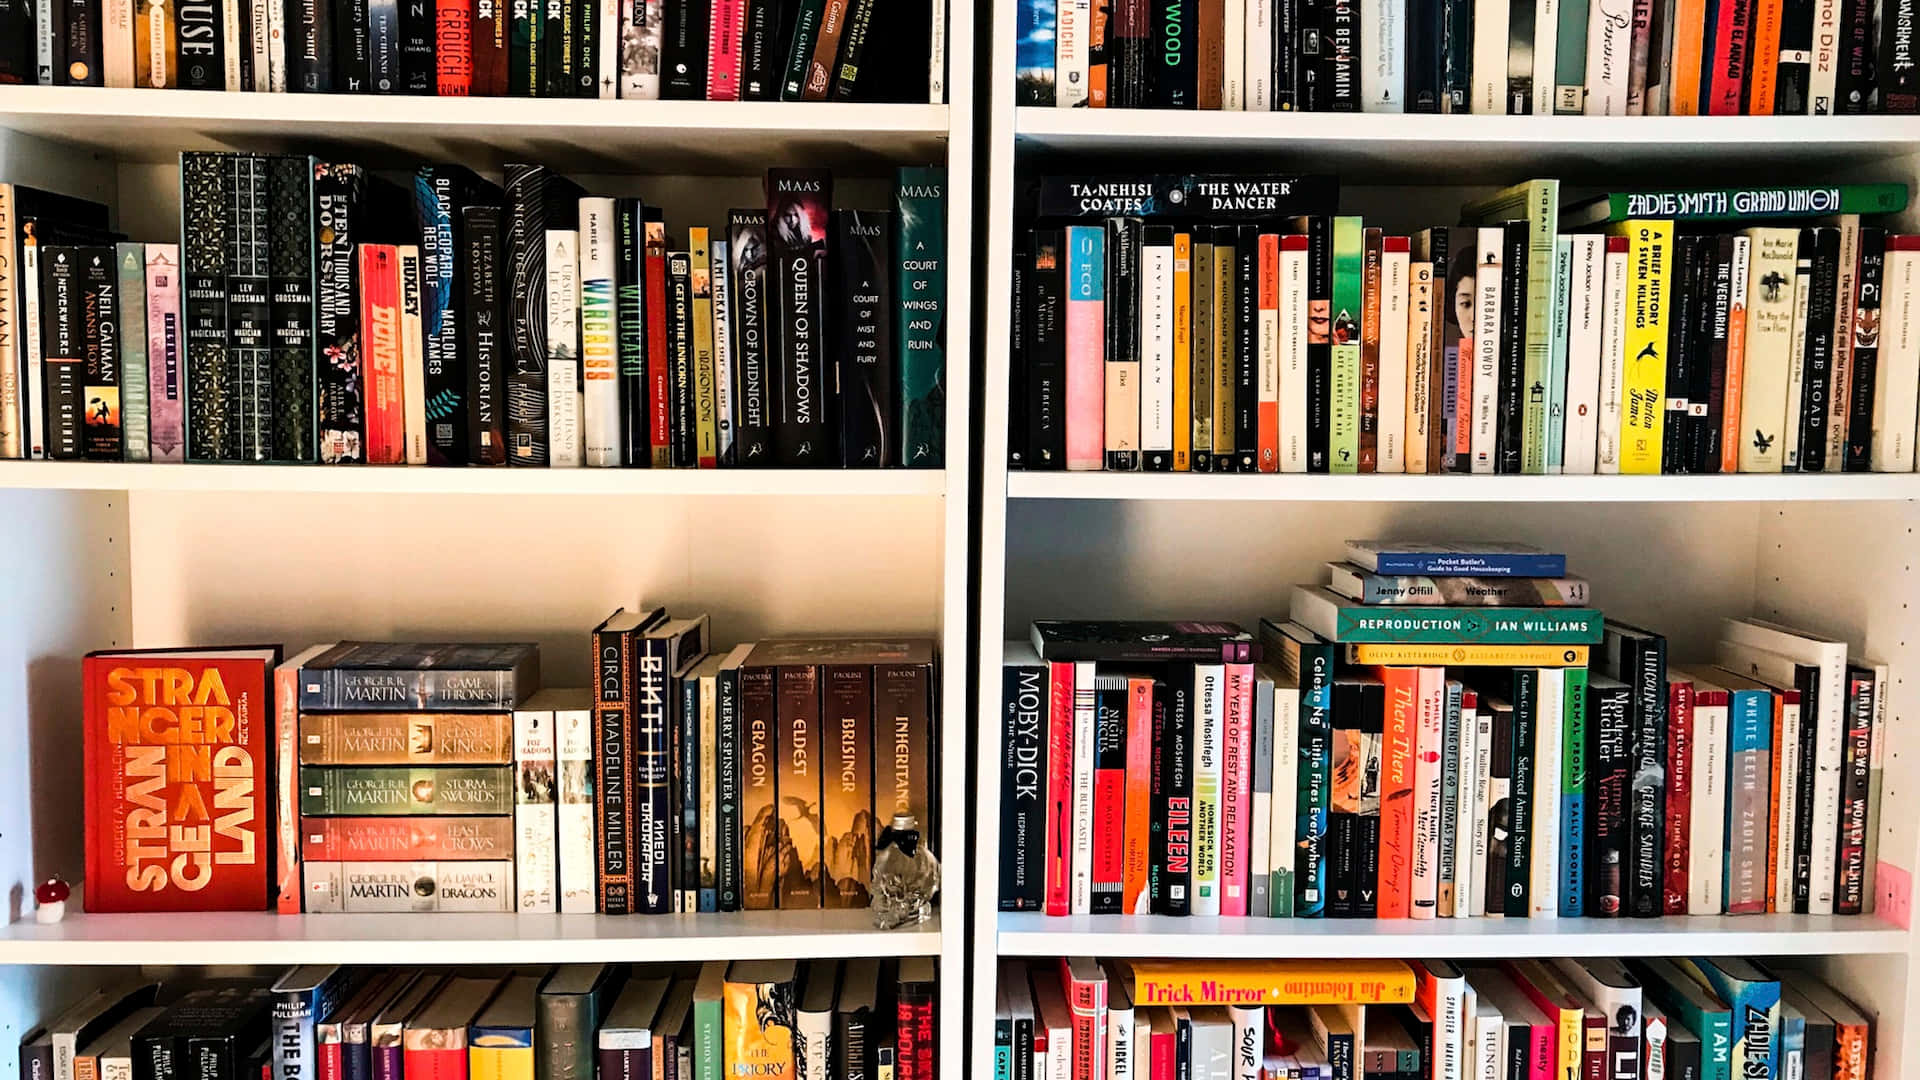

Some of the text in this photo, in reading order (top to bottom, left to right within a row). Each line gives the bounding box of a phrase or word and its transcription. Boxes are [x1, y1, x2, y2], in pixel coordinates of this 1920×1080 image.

[443, 9, 461, 76] CROUCH
[752, 33, 763, 71] GAIMAN
[1061, 10, 1073, 60] ADICHIE
[1336, 28, 1350, 98] BENJAMIN
[779, 179, 820, 191] MAAS
[901, 185, 939, 197] MAAS
[1080, 198, 1142, 211] COATES
[1199, 182, 1290, 195] THE WATER
[1212, 197, 1276, 210] DANCER
[1627, 192, 1727, 215] ZADIE SMITH
[1734, 188, 1840, 212] GRAND UNION
[435, 178, 454, 278] BLACK LEOPARD
[733, 215, 765, 224] MAAS
[916, 241, 925, 250] A
[1640, 229, 1648, 242] OF
[333, 208, 352, 316] TEN THOUSAND
[424, 226, 438, 288] RED WOLF
[515, 205, 526, 299] NIGHT OCEAN
[591, 248, 598, 261] LU
[624, 248, 631, 261] LU
[903, 261, 938, 271] COURT
[1650, 232, 1662, 326] A BRIEF HISTORY
[403, 256, 419, 317] HUXLEY
[903, 300, 938, 310] WINGS
[913, 280, 927, 290] OF
[1081, 264, 1091, 296] ECO
[1636, 280, 1648, 328] KILLINGS
[1714, 262, 1730, 339] THE VEGETARIAN
[58, 278, 68, 354] NEVERWHERE
[86, 292, 97, 376] ANANSI BOYS
[100, 285, 113, 382] NEIL GAIMAN
[321, 281, 335, 336] JANUARY
[440, 310, 456, 360] MARLON
[583, 280, 615, 380] WARCROSS
[619, 285, 644, 376] WILDCARD
[910, 320, 932, 330] AND
[1483, 286, 1496, 377] BARBARA GOWDY
[371, 305, 397, 373] DUNE
[428, 334, 441, 375] JAMES
[675, 283, 687, 391] GET OFF THE UNICORN
[744, 270, 759, 426] CROWN OF MIDNIGHT
[794, 258, 810, 423] QUEEN OF SHADOWS
[908, 340, 932, 350] RUIN
[478, 331, 493, 422] HISTORIAN
[1810, 336, 1825, 428] THE ROAD
[1630, 388, 1644, 426] James
[1645, 388, 1659, 430] Marlon
[1376, 584, 1507, 597] Jenny Offill Weather
[1359, 619, 1588, 631] REPRODUCTION IAN WILLIAMS
[604, 647, 618, 700] CIRCE
[1309, 656, 1325, 729] Celeste Ng
[723, 698, 732, 738] MERRY
[1016, 672, 1040, 800] MOBY-DICK
[1099, 707, 1109, 753] CIRCUS
[1203, 676, 1214, 768] Ottessa Moshfegh
[1391, 688, 1411, 784] There There
[1600, 699, 1617, 762] Richler
[1614, 691, 1629, 758] Mordecai
[1744, 696, 1757, 789] WHITE TEETH
[1855, 681, 1870, 776] MIRIAM TOEWS
[723, 741, 733, 800] SPINSTER
[752, 720, 765, 787] ERAGON
[793, 719, 806, 776] ELDEST
[841, 718, 855, 792] BRISINGR
[1175, 736, 1183, 787] MOSHFEGH
[1675, 729, 1685, 792] SELVADURAI
[605, 713, 623, 871] MADELINE MILLER
[1225, 674, 1240, 877] MY YEAR OF REST AND RELAXATION
[214, 746, 255, 864] LAND
[1305, 738, 1323, 882] Little Fires Everywhere
[1168, 798, 1189, 872] EILEEN
[1639, 785, 1654, 889] GEORGE SAUNDERS
[1847, 800, 1864, 902] WOMEN TALKING
[350, 883, 409, 897] MARTIN
[442, 888, 496, 898] DRAGONS
[272, 1010, 311, 1018] PULLMAN
[277, 1002, 305, 1010] PHILIP
[1144, 980, 1266, 1002] Trick Mirror
[1284, 981, 1385, 1000] Jia Tolentino
[1446, 996, 1456, 1034] SPINSTER
[732, 1063, 786, 1077] PRIORY
[751, 1049, 768, 1057] THE
[1115, 1040, 1127, 1075] NICKEL
